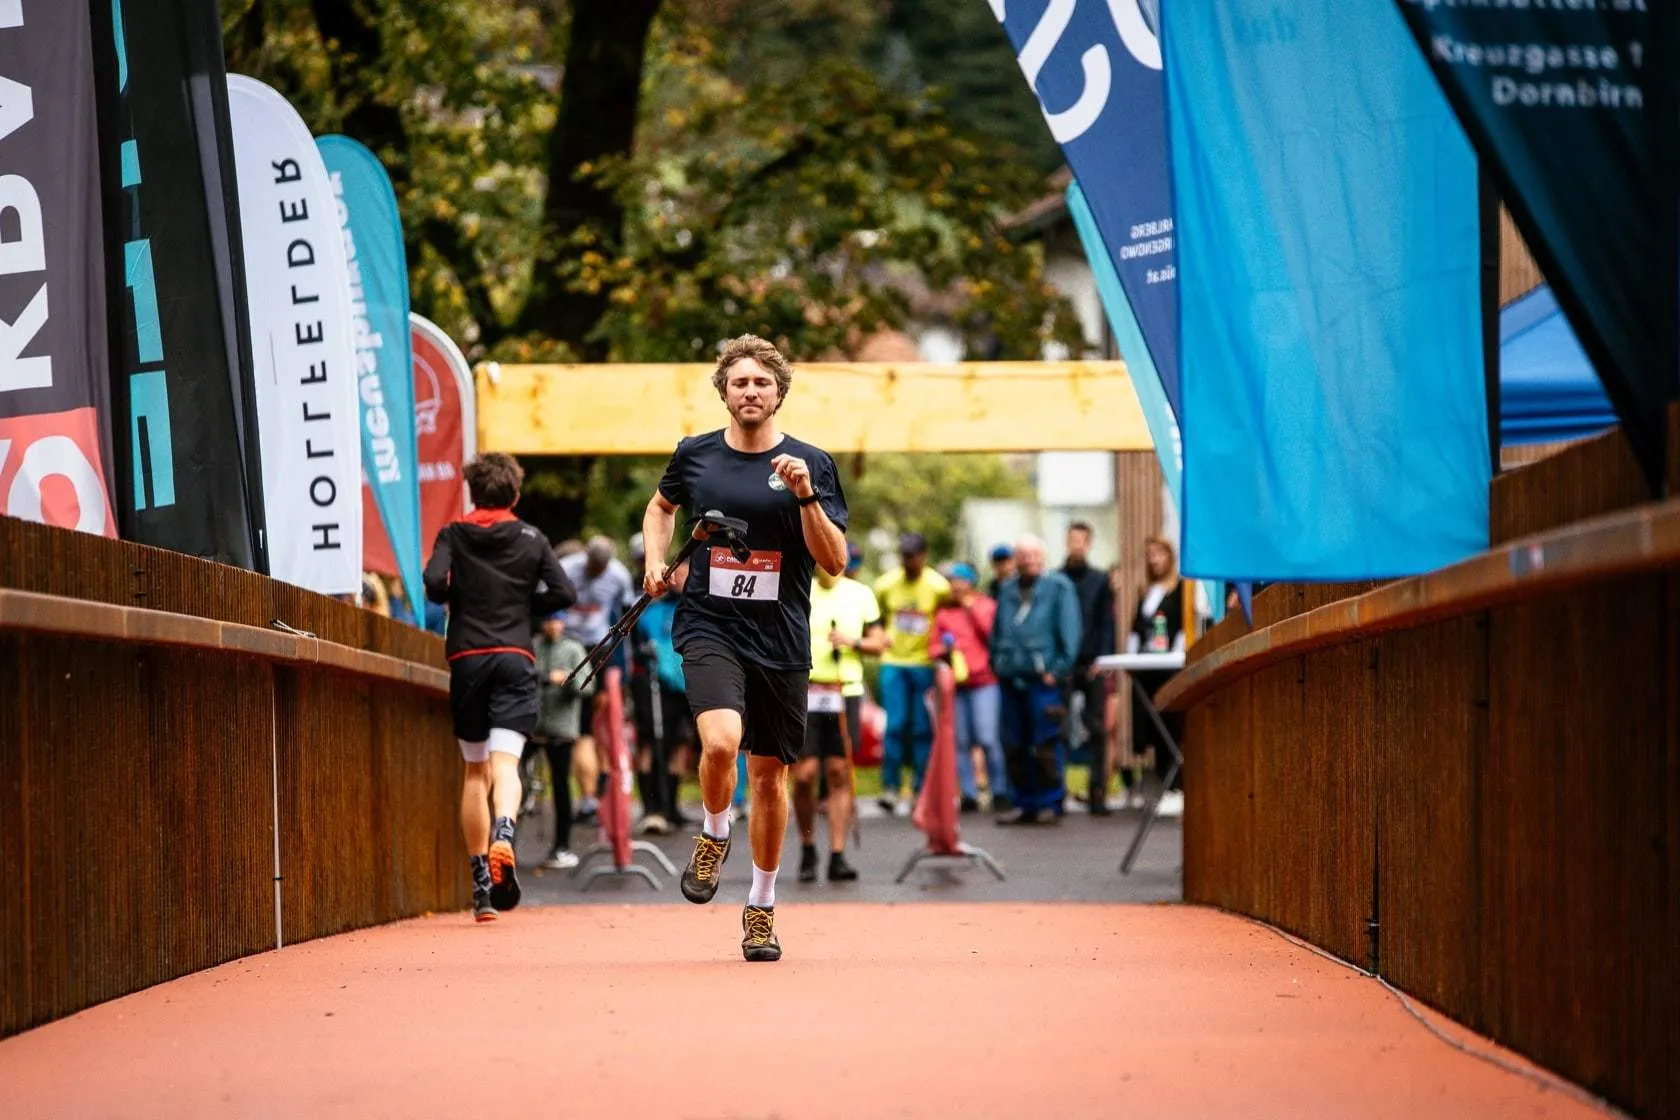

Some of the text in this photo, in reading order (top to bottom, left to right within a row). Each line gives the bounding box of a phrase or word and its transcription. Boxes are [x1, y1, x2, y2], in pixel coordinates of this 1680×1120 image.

[1431, 35, 1619, 75] Kreuzgasse
[1492, 75, 1644, 109] Dornbirn
[731, 574, 757, 598] 84
